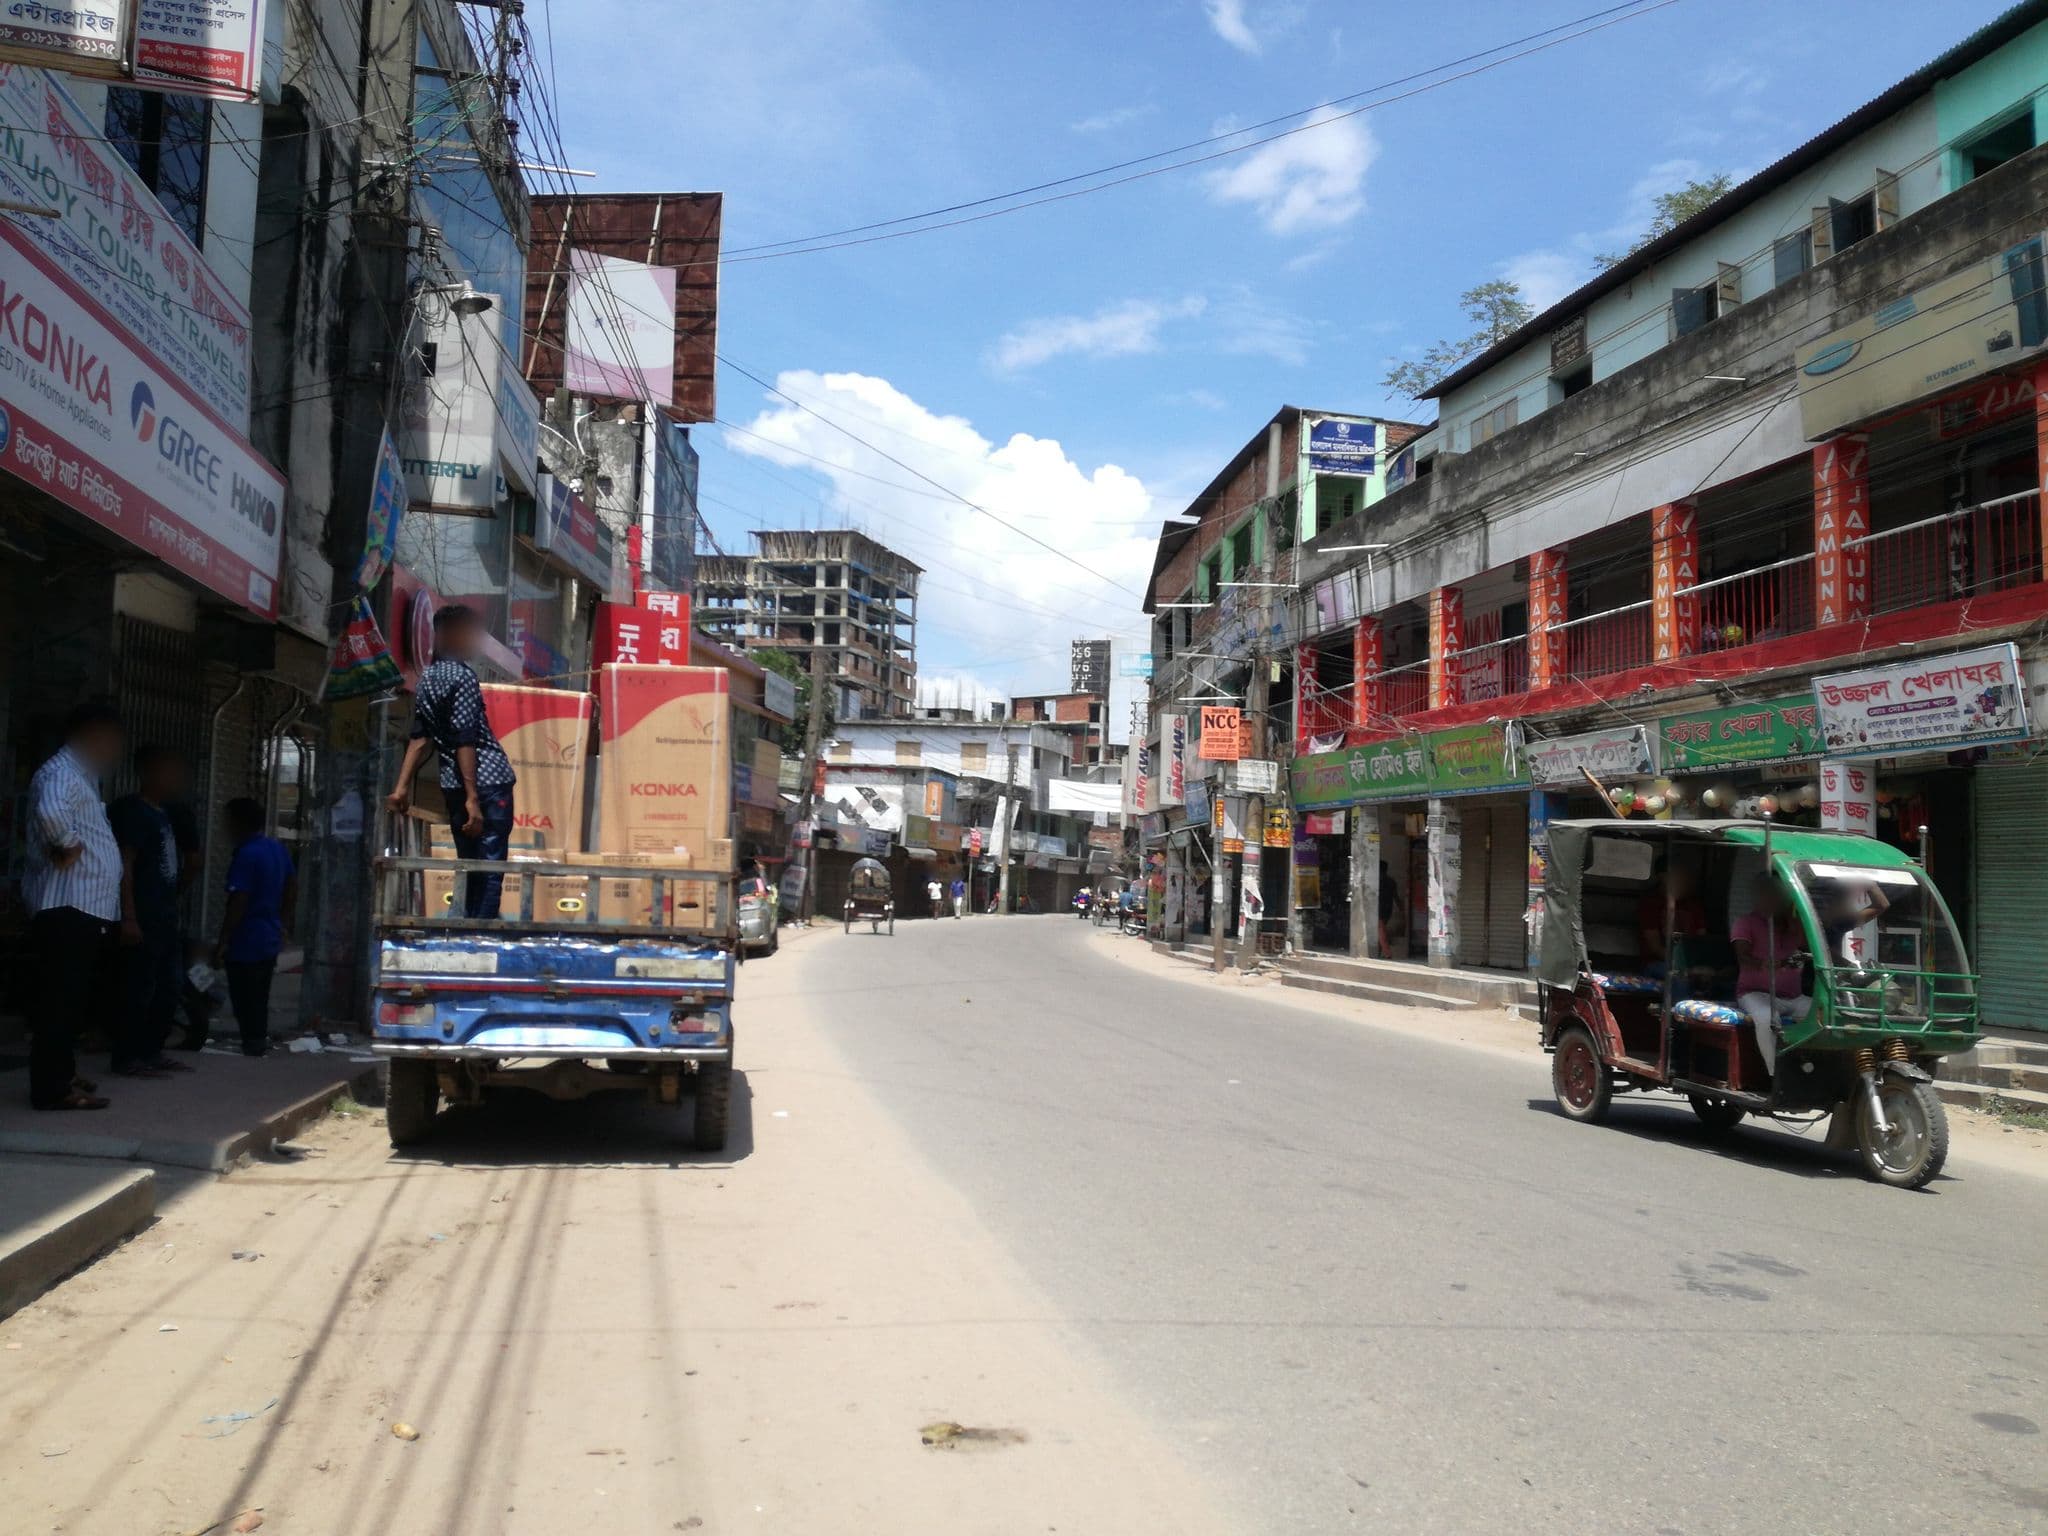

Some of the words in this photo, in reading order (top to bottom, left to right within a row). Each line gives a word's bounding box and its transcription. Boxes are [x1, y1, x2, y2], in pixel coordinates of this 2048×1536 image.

[84, 207, 156, 303] TOURS
[162, 295, 174, 321] &
[180, 306, 247, 395] TRAVELS
[0, 280, 113, 417] KONKA
[1925, 358, 1977, 386] RUNNER
[39, 371, 67, 409] Home
[68, 391, 114, 444] Appliances
[158, 415, 223, 497] GREE
[1819, 486, 1837, 625] JAMUNA
[1656, 540, 1670, 660] JAMUNA
[1902, 660, 2006, 698] খেলাঘর
[1203, 713, 1238, 730] NCC
[1665, 720, 1713, 745] স্টার
[1719, 709, 1775, 740] খেলা
[1779, 704, 1818, 730] ঘর
[630, 783, 698, 797] KONKA
[1370, 746, 1404, 783] হোমিও
